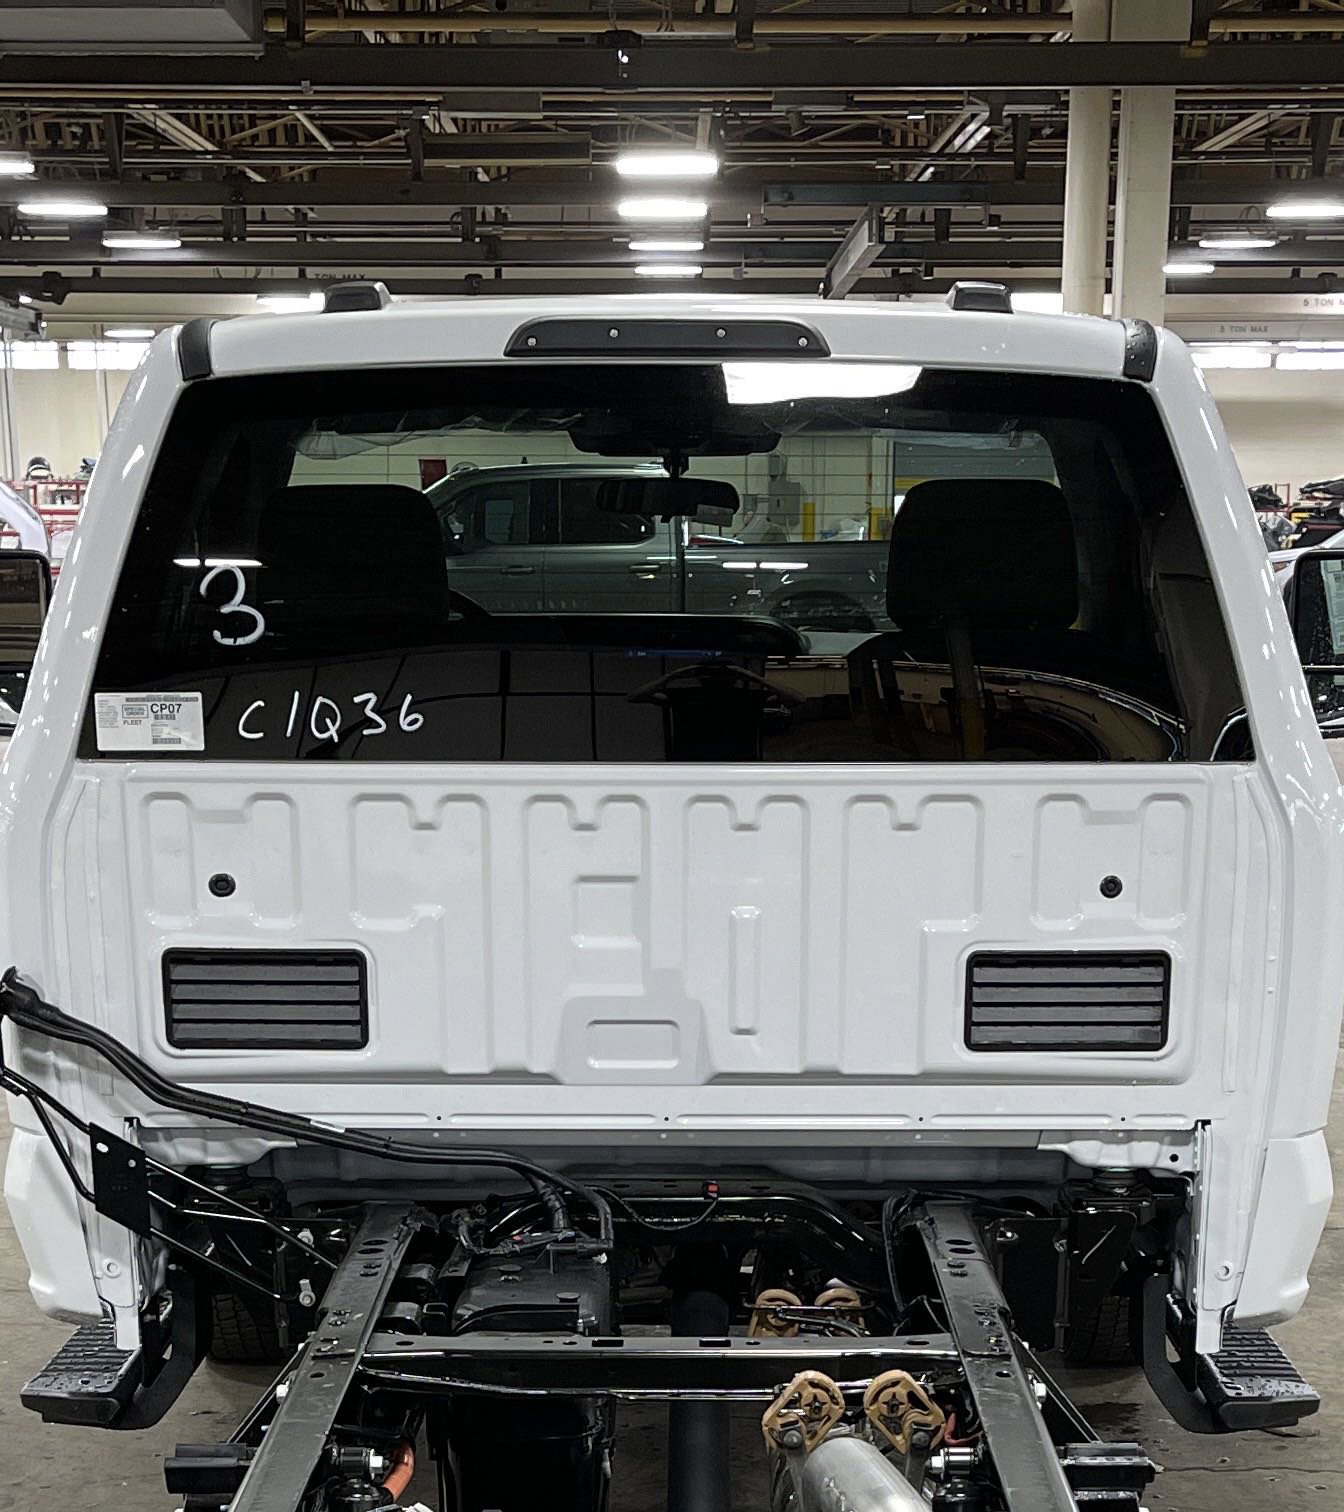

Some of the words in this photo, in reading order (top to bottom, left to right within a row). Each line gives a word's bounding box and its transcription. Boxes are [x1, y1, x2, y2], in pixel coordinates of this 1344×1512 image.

[1315, 298, 1334, 306] TON
[199, 564, 265, 646] 3
[150, 703, 182, 714] CP07
